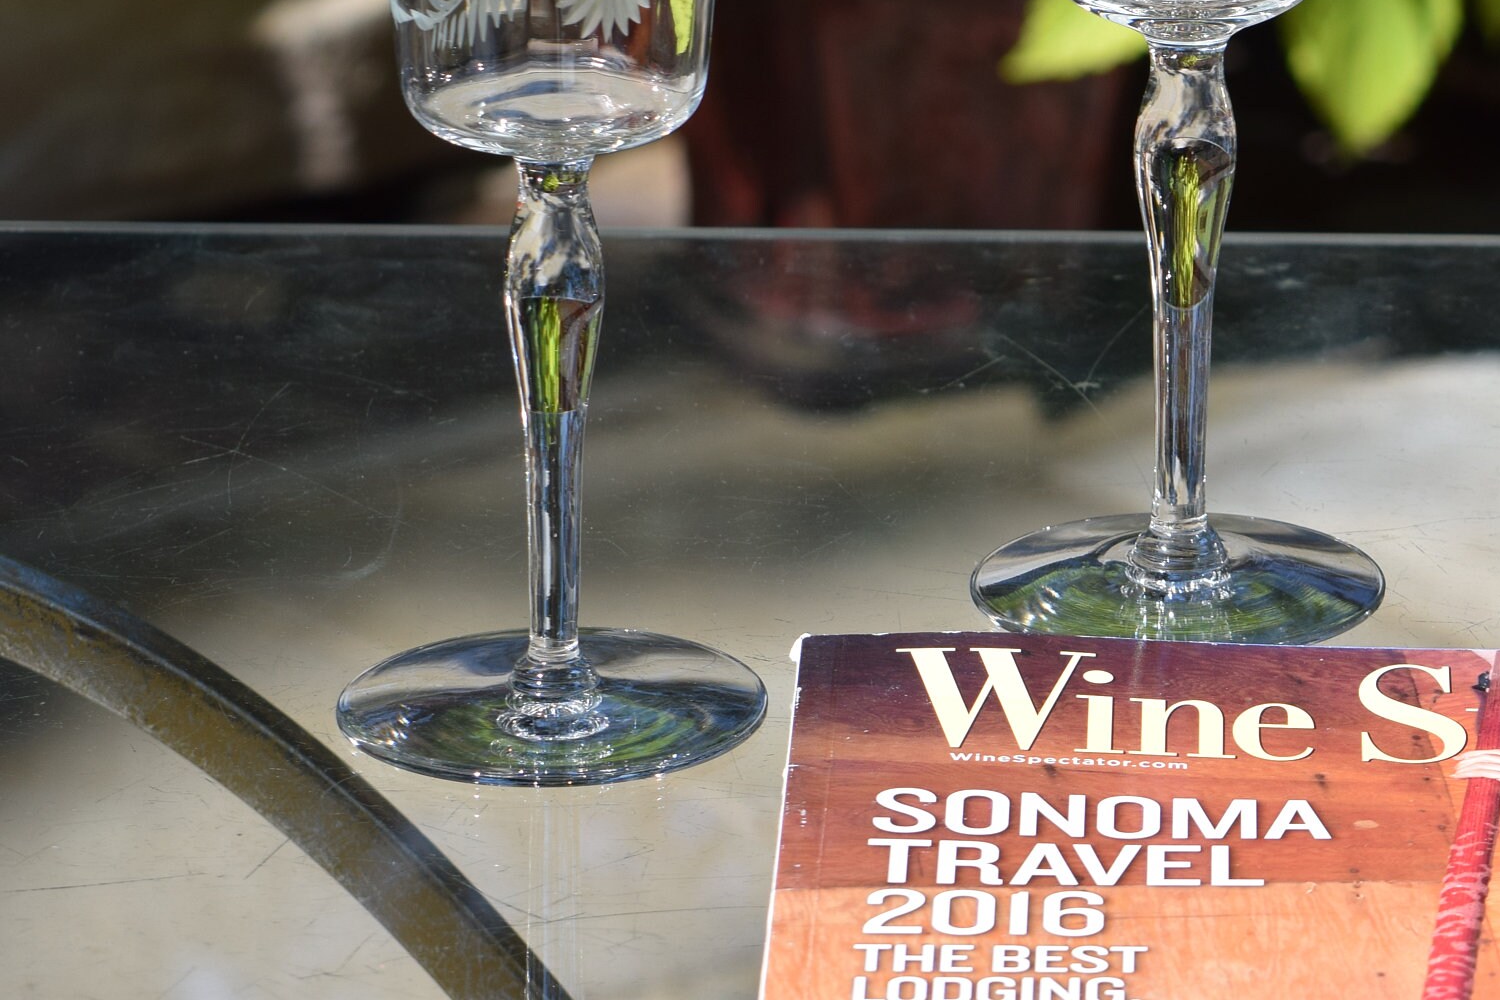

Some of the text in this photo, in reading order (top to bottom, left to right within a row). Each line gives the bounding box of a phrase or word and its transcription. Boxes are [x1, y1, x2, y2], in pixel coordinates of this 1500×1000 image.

[895, 647, 1315, 761] Wine
[949, 752, 1189, 770] WineSpectator.com
[871, 787, 1332, 840] SONOMA
[867, 837, 1265, 887] TRAVEL
[861, 888, 1105, 937] 2016
[852, 943, 1149, 974] THE BEST
